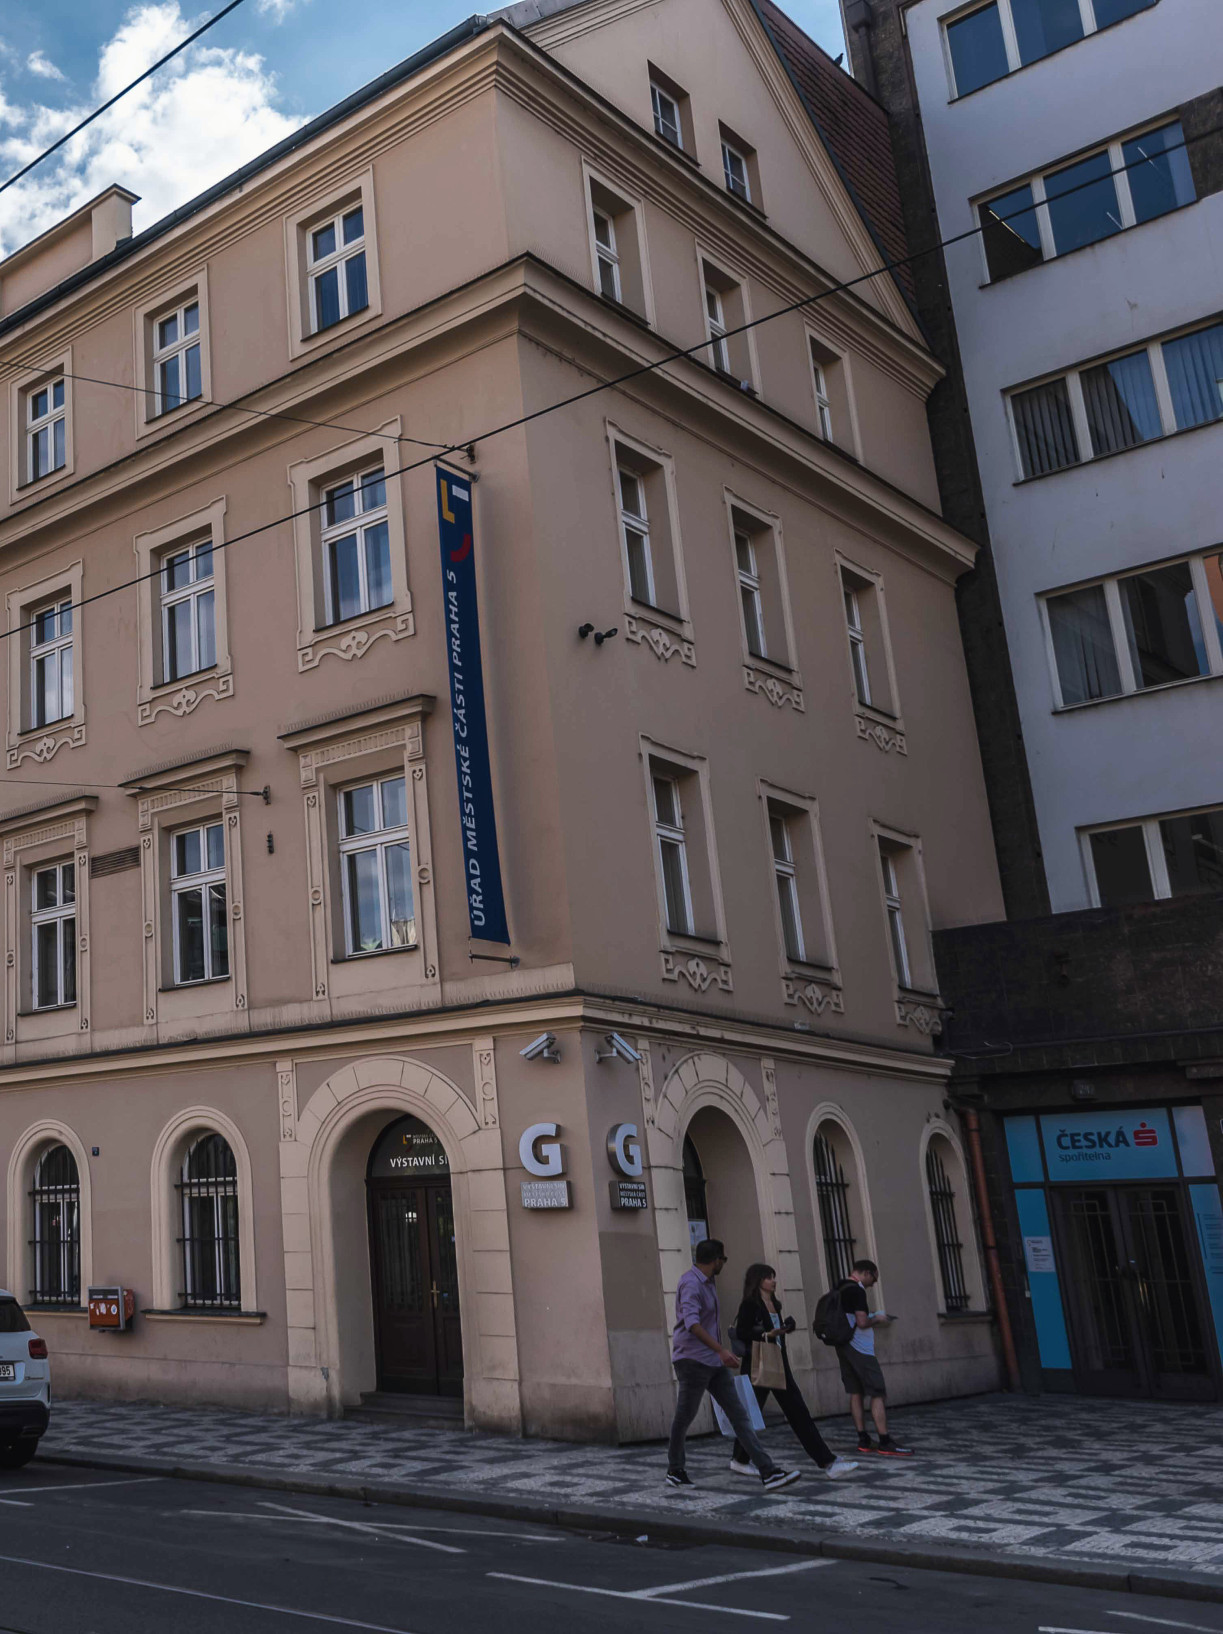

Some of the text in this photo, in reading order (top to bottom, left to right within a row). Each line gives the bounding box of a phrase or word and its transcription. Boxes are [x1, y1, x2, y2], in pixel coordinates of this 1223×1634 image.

[446, 569, 486, 927] ÚŘAD MĚSTSKÉ ČÁSTI PRAHA 5
[413, 1137, 433, 1145] PRAHA
[1056, 1126, 1130, 1150] ČESKÁ
[518, 1122, 564, 1177] G
[614, 1123, 643, 1177] G
[1058, 1151, 1112, 1163] spořitelna
[390, 1153, 447, 1168] VÝSTAVNÍ SÍ
[524, 1198, 558, 1207] PRAHA
[620, 1197, 647, 1208] PRAHA 5
